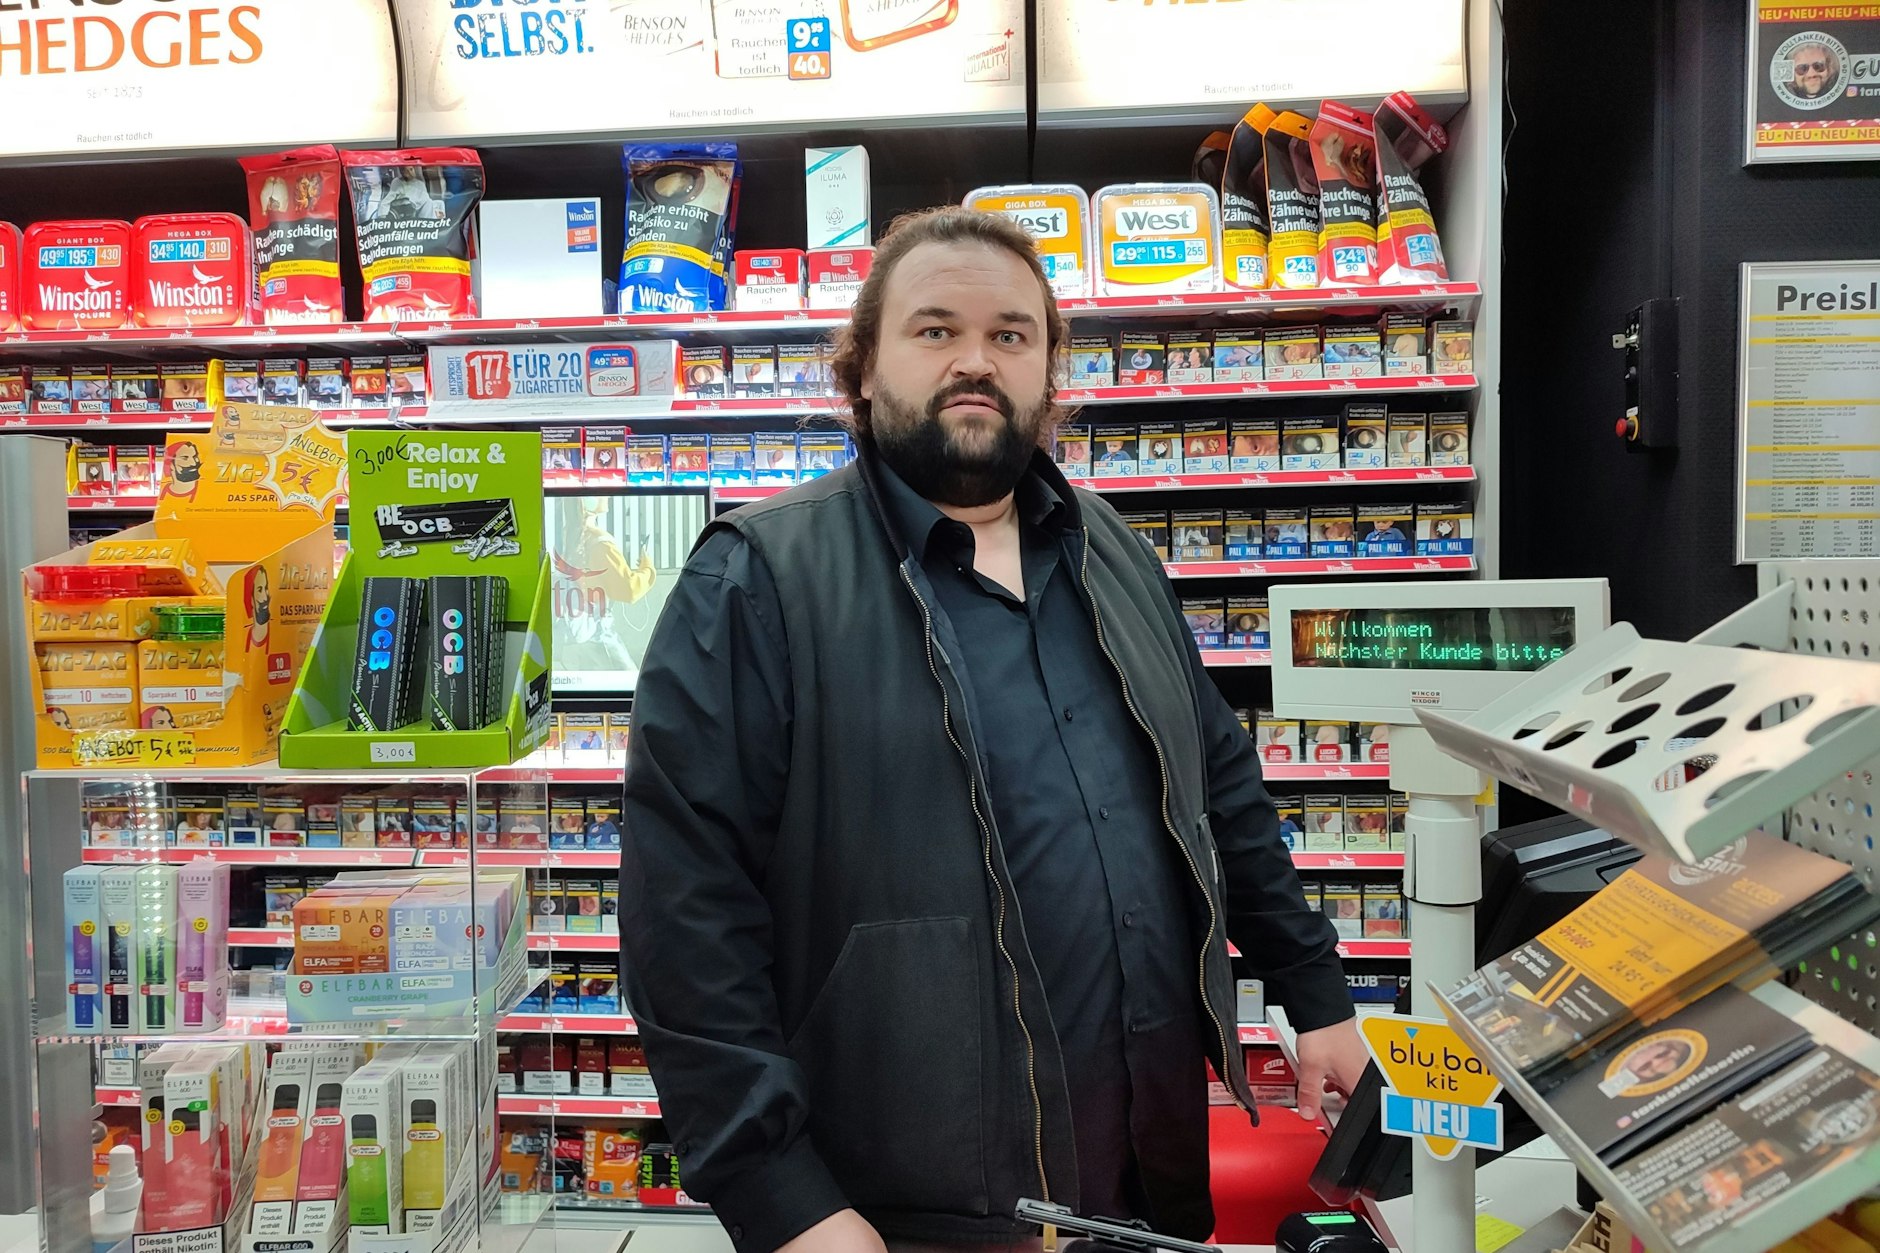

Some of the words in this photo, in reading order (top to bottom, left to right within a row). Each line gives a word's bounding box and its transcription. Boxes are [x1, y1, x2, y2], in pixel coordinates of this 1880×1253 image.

[1789, 9, 1817, 19] NEU
[1824, 7, 1853, 18] NEU
[624, 14, 687, 30] BENSON
[454, 9, 594, 59] SELBST.
[0, 5, 263, 76] HEDGES
[731, 37, 787, 49] Rauchen
[752, 53, 767, 62] ist
[967, 51, 1008, 75] QUALITY
[1204, 84, 1245, 95] Rauchen
[669, 109, 708, 118] Rauchen
[77, 134, 112, 143] Rauchen
[1783, 130, 1812, 141] NEU
[1820, 129, 1849, 140] NEU
[820, 173, 848, 182] ILUMA
[1005, 201, 1027, 210] GIGA
[1029, 199, 1048, 208] BOX
[1132, 198, 1156, 206] MEGA
[1158, 197, 1178, 206] BOX
[569, 211, 595, 222] Winston
[668, 203, 710, 223] erhöht
[1224, 207, 1253, 222] Zähne
[1271, 203, 1304, 218] Zähne
[1343, 203, 1371, 220] Lunge
[394, 217, 452, 230] verursacht
[674, 219, 689, 231] zu
[1121, 209, 1191, 232] West
[286, 223, 338, 242] schädigt
[416, 229, 439, 241] und
[1186, 246, 1204, 256] 255
[1056, 261, 1075, 272] 540
[1345, 263, 1359, 272] 90
[758, 273, 787, 285] Winston
[831, 271, 860, 282] Winston
[149, 279, 224, 308] Winston
[746, 285, 788, 295] Rauchen
[819, 283, 862, 293] Rauchen
[39, 283, 112, 312] Winston
[639, 283, 694, 313] Winston
[761, 296, 773, 305] ist
[835, 294, 847, 303] ist
[73, 311, 112, 319] VOLUME
[185, 308, 224, 316] VOLUME
[513, 348, 551, 379] FÜR
[557, 352, 583, 379] 20
[448, 356, 456, 396] ENTSPRICHT
[599, 375, 629, 383] BENSON
[515, 379, 583, 395] ZIGARETTEN
[40, 402, 62, 412] West
[125, 401, 147, 411] West
[175, 400, 198, 410] West
[251, 410, 307, 424] ZIG-ZAG
[355, 434, 412, 475] 3,00€
[406, 443, 481, 464] Relax
[486, 443, 506, 464] &
[407, 468, 480, 493] Enjoy
[227, 494, 247, 502] DAS
[377, 504, 405, 526] BE
[401, 517, 453, 536] OCB
[1228, 547, 1242, 556] PALL
[1245, 546, 1260, 556] MALL
[1367, 543, 1383, 553] PALL
[1386, 542, 1403, 553] MALL
[1427, 543, 1442, 552] PALL
[1446, 541, 1462, 551] MALL
[94, 546, 173, 561] ZIG-ZAG
[278, 562, 328, 591] ZIG-ZAG
[279, 605, 294, 617] DAS
[39, 611, 120, 632] ZIG-ZAG
[1314, 621, 1432, 638] Willkommen
[369, 606, 396, 671] OCB
[442, 608, 464, 676] OCB
[1420, 643, 1483, 661] Kunde
[1496, 643, 1564, 662] bitte
[40, 649, 128, 672] ZIG-ZAG
[275, 657, 285, 669] 10
[80, 689, 92, 703] 10
[184, 688, 197, 702] 10
[299, 909, 385, 924] ELFBAR
[394, 910, 486, 924] ELFBAR
[303, 957, 328, 967] ELFA
[397, 960, 422, 969] ELFA
[321, 978, 394, 993] ELFBAR
[401, 978, 426, 988] ELFA
[347, 994, 398, 1003] CRANBERRY
[400, 992, 429, 1001] GRAPE
[275, 1056, 308, 1065] ELFBAR
[316, 1056, 350, 1065] ELFBAR
[406, 1072, 440, 1080] ELFBAR
[1426, 1072, 1459, 1092] kit
[167, 1079, 204, 1088] ELFBAR
[1412, 1098, 1470, 1139] NEU
[602, 1135, 615, 1153] 6
[616, 1144, 637, 1153] SLIM
[584, 1130, 597, 1177] GIZEH
[306, 1205, 326, 1213] Dieses
[260, 1214, 283, 1222] Produkt
[303, 1212, 326, 1222] Produkt
[138, 1233, 173, 1247] Dieses
[176, 1230, 218, 1243] Produkt
[176, 1241, 218, 1253] Nikotin:
[259, 1242, 292, 1251] ELFBAR
[292, 1241, 309, 1251] 600
